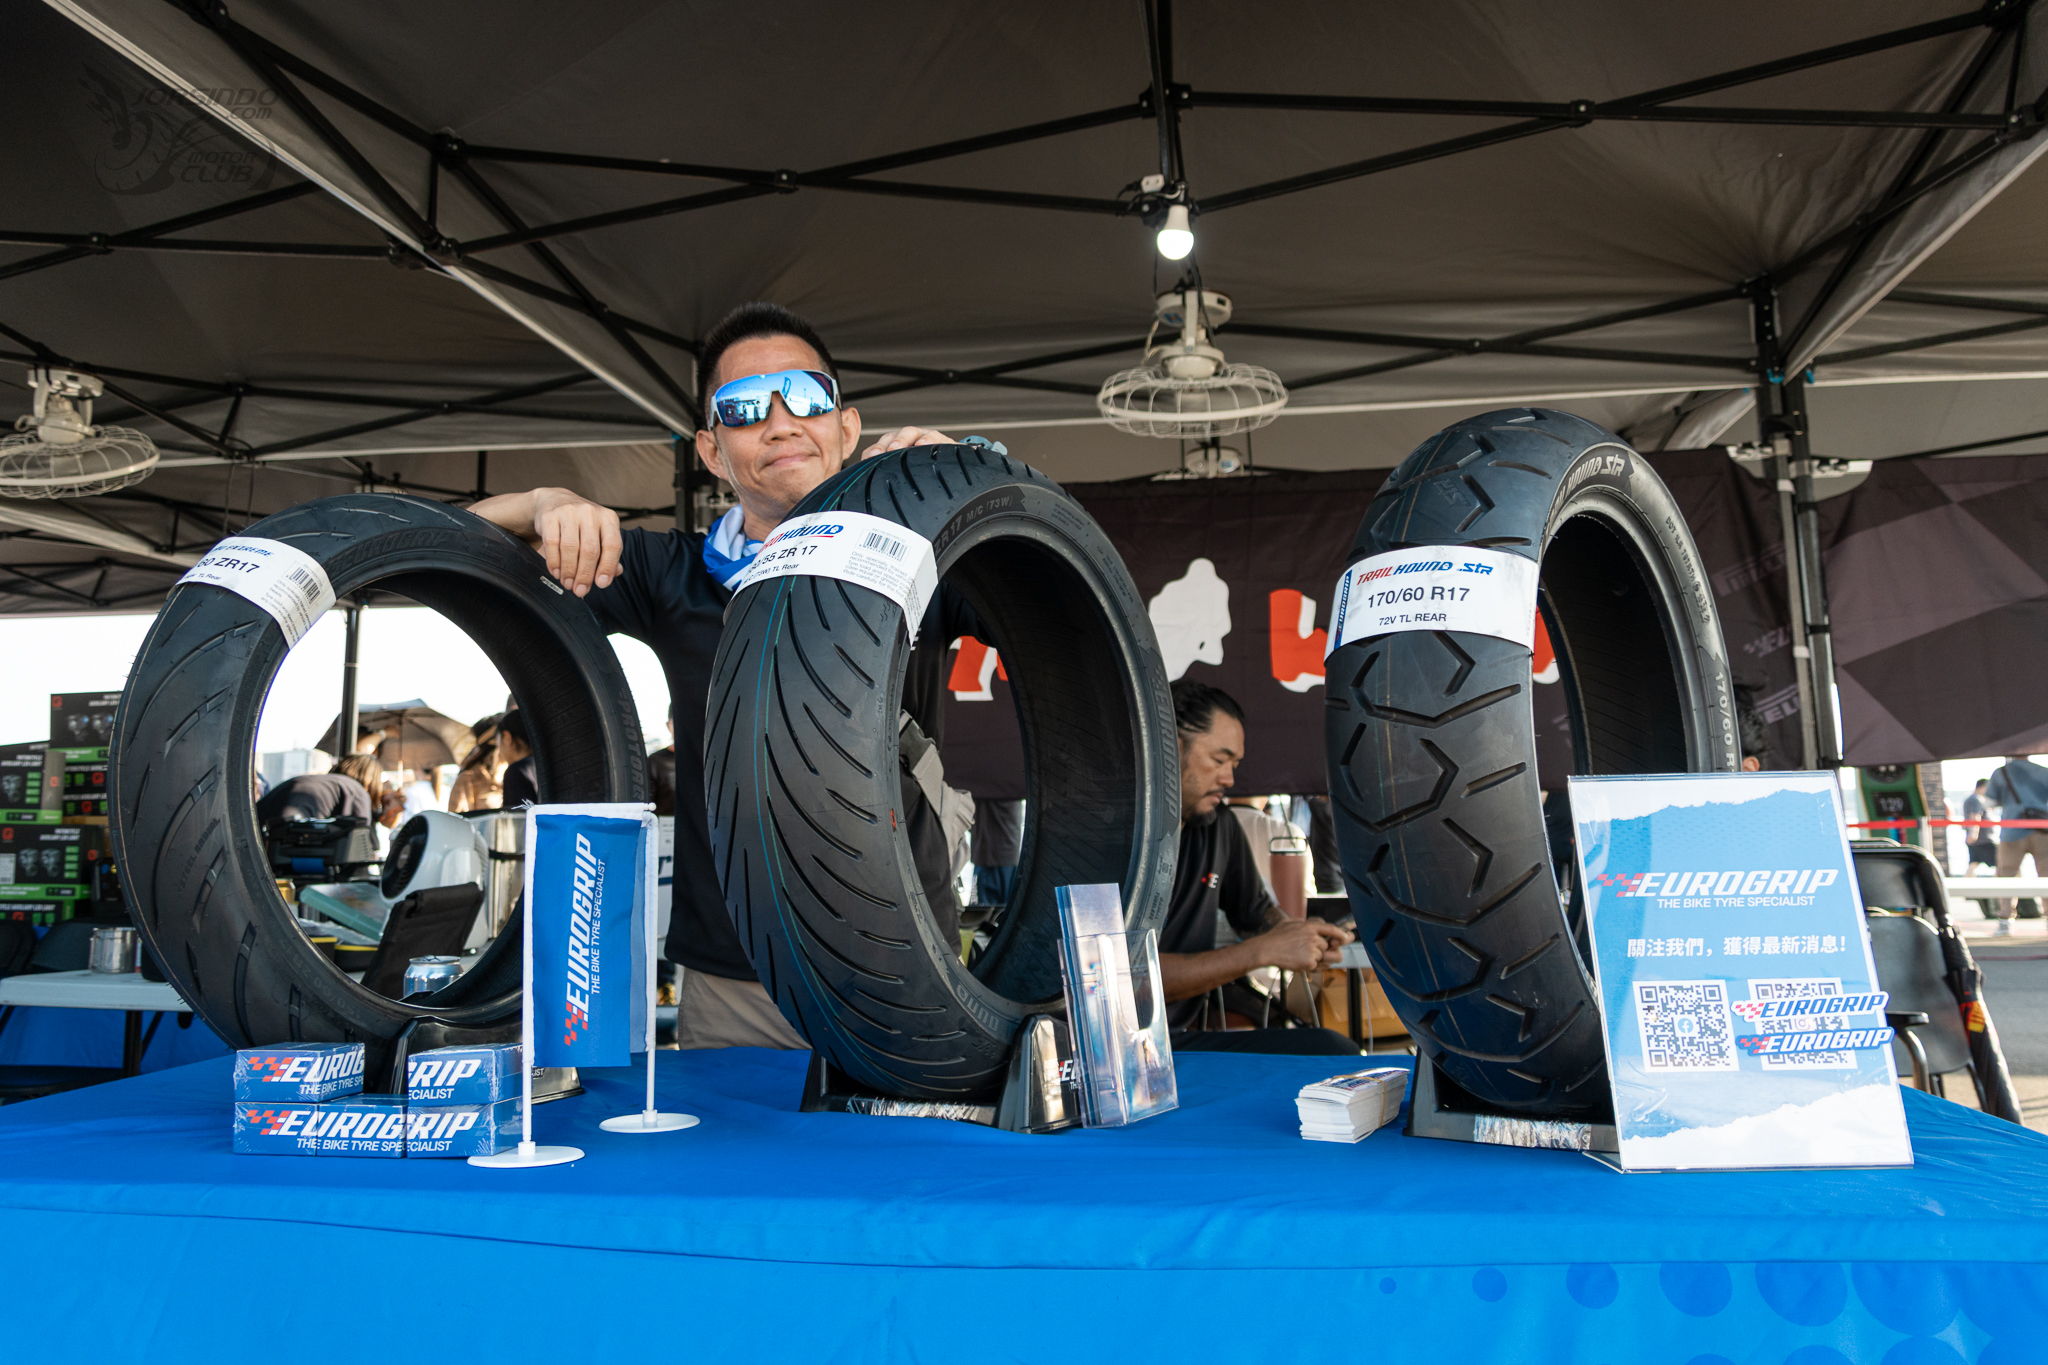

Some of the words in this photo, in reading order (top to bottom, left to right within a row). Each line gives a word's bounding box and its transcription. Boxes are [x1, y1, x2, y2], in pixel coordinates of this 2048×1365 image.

[949, 514, 963, 537] 17
[966, 504, 984, 524] M/C
[214, 557, 260, 573] ZR17
[777, 547, 798, 560] ZR
[800, 545, 819, 556] 17
[781, 563, 800, 571] Rear
[1368, 586, 1425, 609] 170/60
[1430, 586, 1471, 602] R17
[1378, 615, 1397, 627] 72V
[1399, 614, 1412, 624] TL
[1414, 613, 1447, 622] REAR
[1714, 671, 1734, 747] 170/60
[1153, 688, 1179, 819] EUROGRIP
[592, 859, 606, 918] SPECIALIST
[1634, 869, 1840, 897] EUROGRIP
[1656, 898, 1682, 909] THE
[1683, 897, 1712, 909] BIKE
[1714, 897, 1745, 908] TYRE
[1747, 896, 1816, 908] SPECIALIST
[566, 832, 592, 1013] EUROGRIP
[591, 917, 601, 946] TYRE
[591, 946, 601, 975] BIKE
[591, 976, 601, 995] THE
[1760, 994, 1886, 1019] EUROGRIP
[1764, 1029, 1893, 1054] EUROGRIP
[299, 1083, 321, 1095] THE
[321, 1081, 338, 1094] BIKE
[337, 1078, 354, 1091] TYRE
[297, 1137, 321, 1150] THE
[322, 1139, 349, 1151] BIKE
[351, 1139, 379, 1152] TYRE
